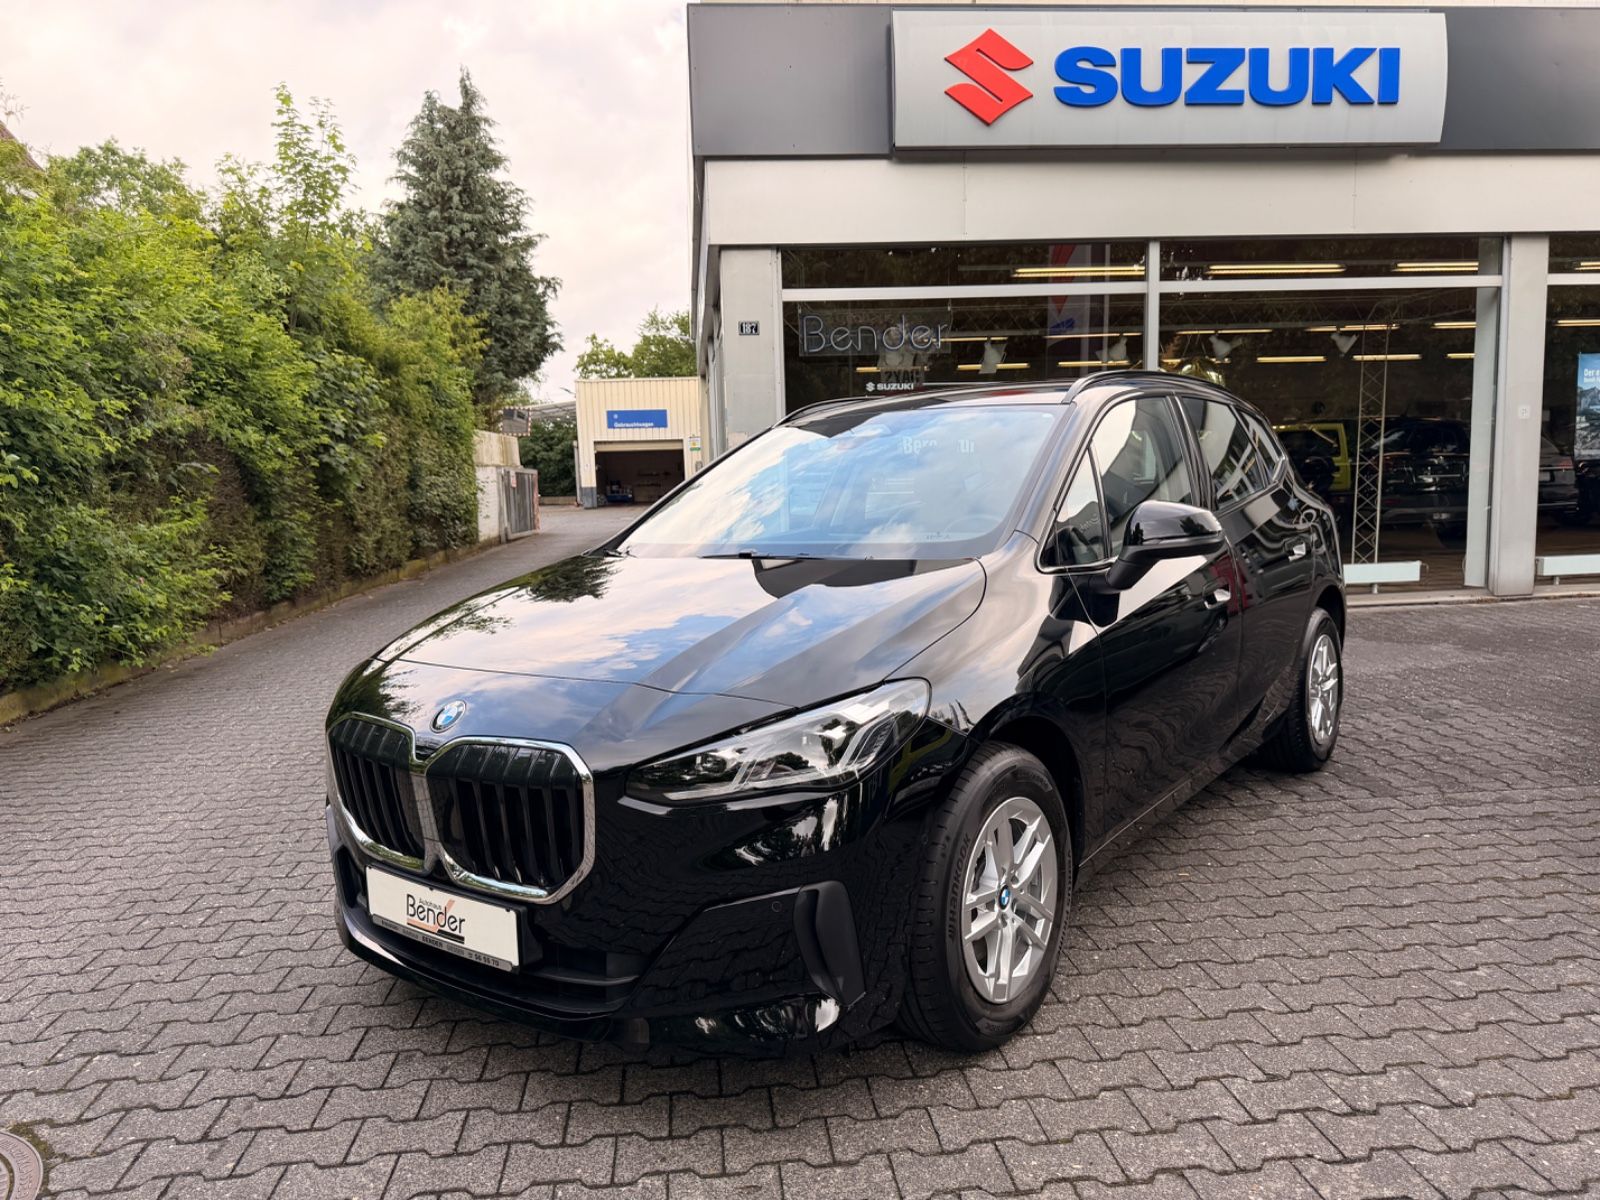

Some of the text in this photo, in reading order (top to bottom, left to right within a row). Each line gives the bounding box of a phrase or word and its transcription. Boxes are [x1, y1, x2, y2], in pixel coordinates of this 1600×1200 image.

[1053, 46, 1401, 108] SUZUKI
[741, 321, 758, 335] 187
[803, 314, 949, 353] Bender
[876, 382, 914, 391] SUZUKI
[406, 893, 466, 934] Bender
